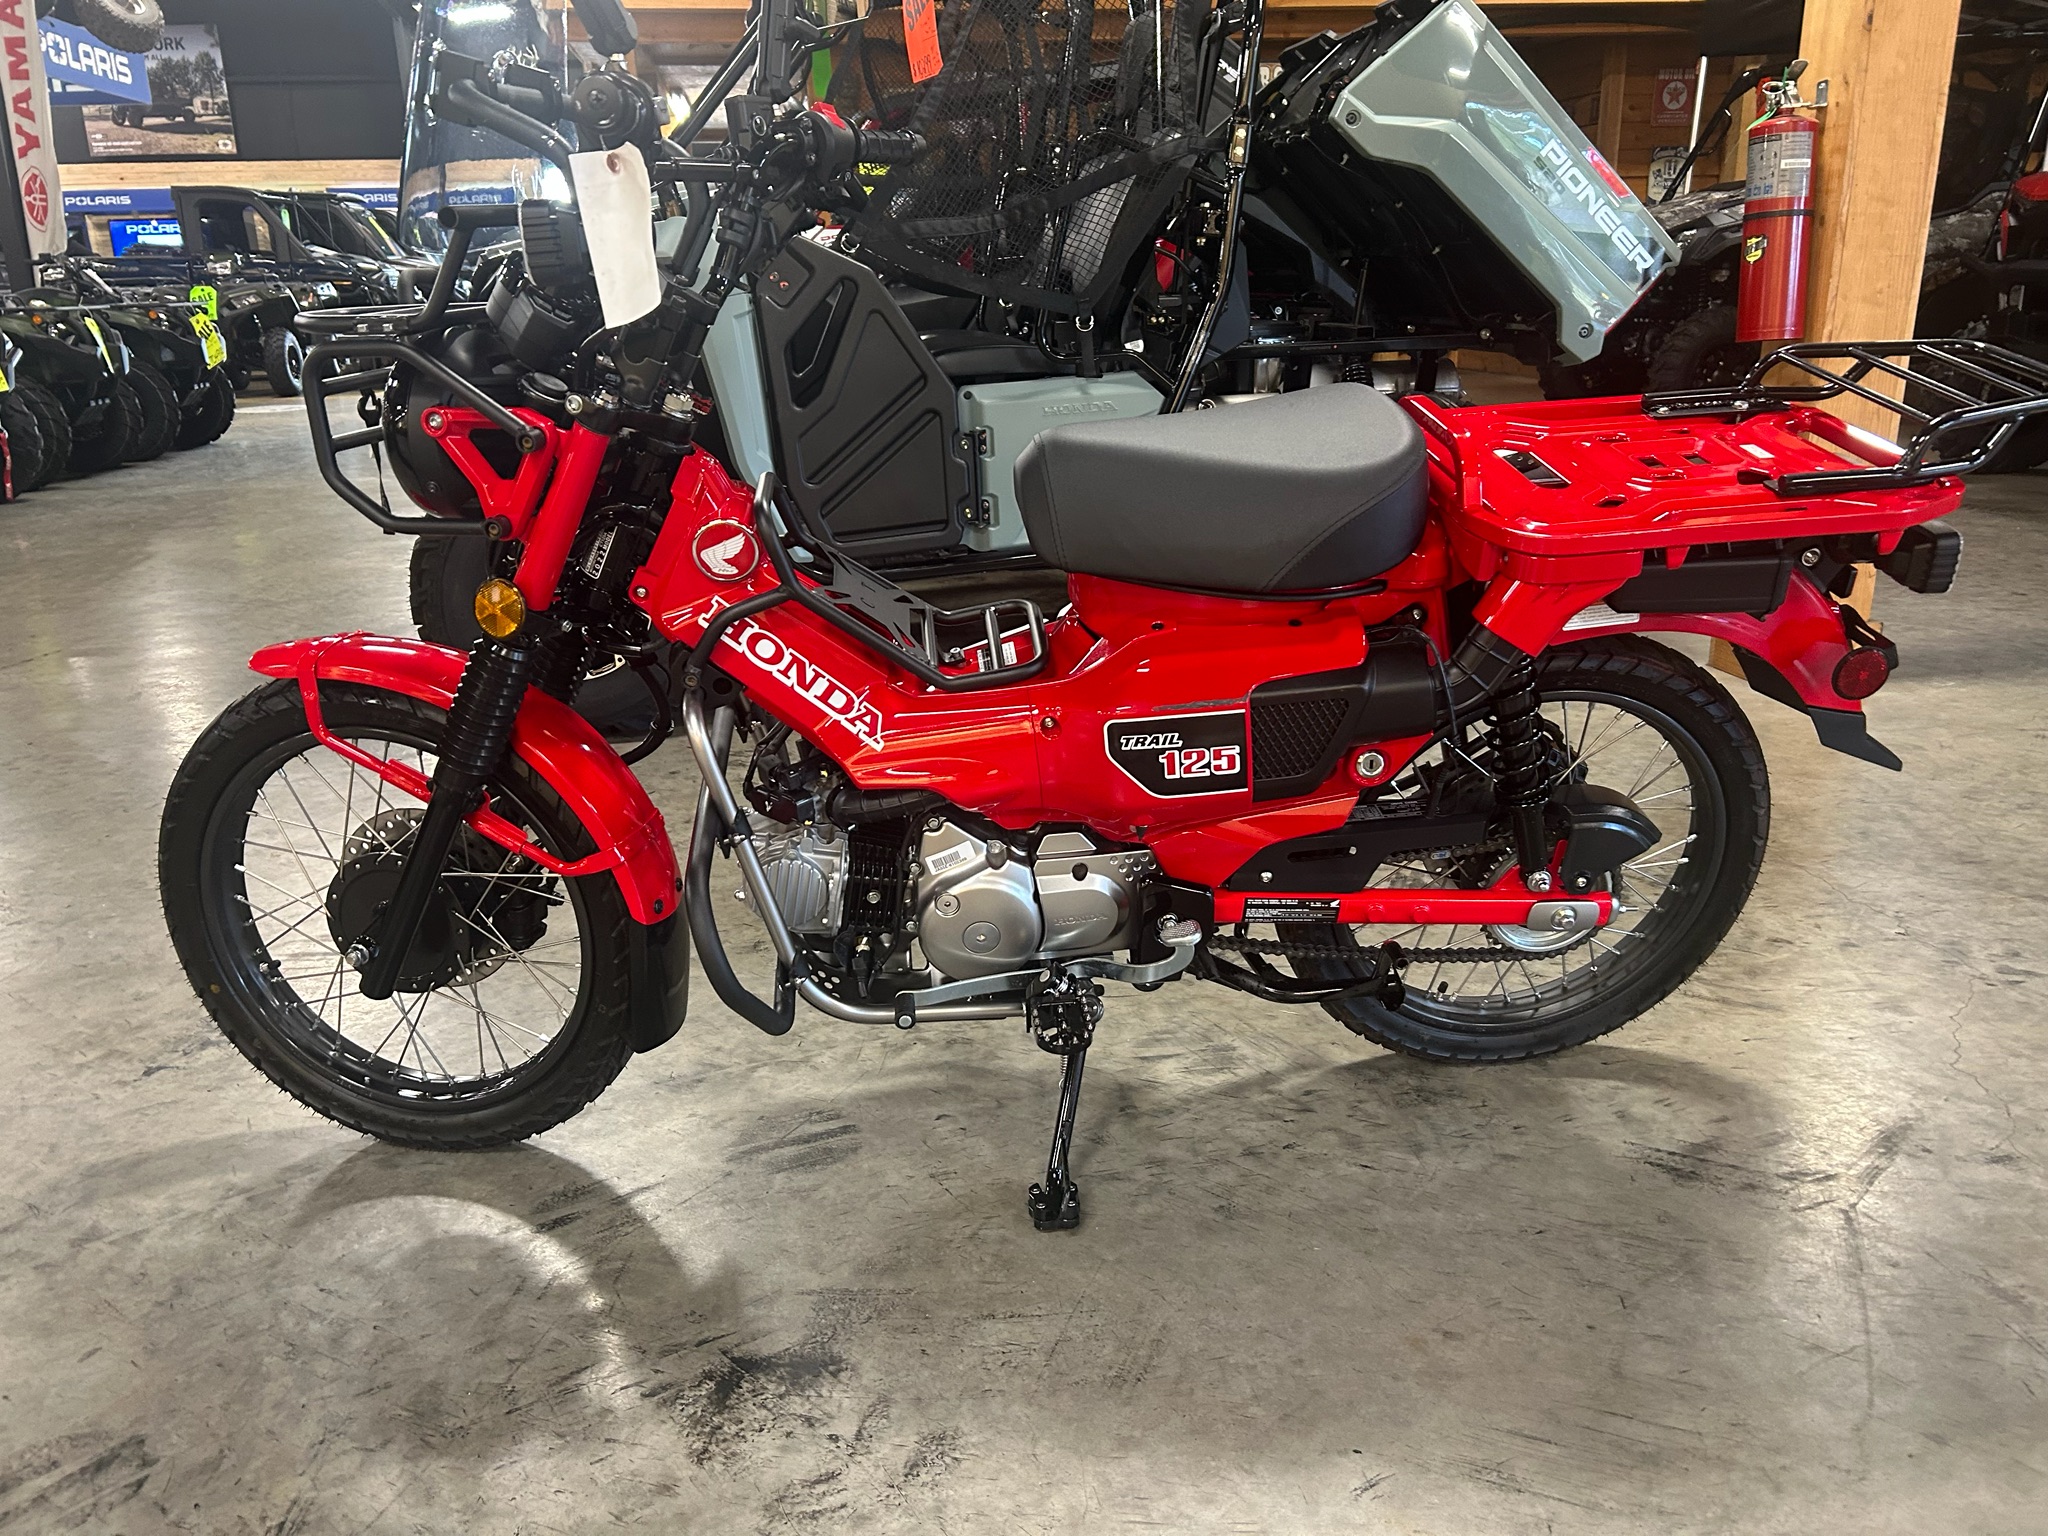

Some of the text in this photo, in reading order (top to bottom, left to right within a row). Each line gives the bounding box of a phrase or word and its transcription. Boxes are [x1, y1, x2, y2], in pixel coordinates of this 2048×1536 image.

[154, 36, 187, 51] ORK
[64, 195, 132, 207] POLARIS
[1540, 138, 1655, 274] PIONEER
[191, 292, 214, 302] SALE
[198, 320, 213, 340] ALE
[1042, 400, 1118, 417] HONDA
[592, 550, 606, 576] 2022
[698, 595, 885, 752] HONDA
[1120, 733, 1183, 750] TRAIL
[1159, 745, 1241, 779] 125
